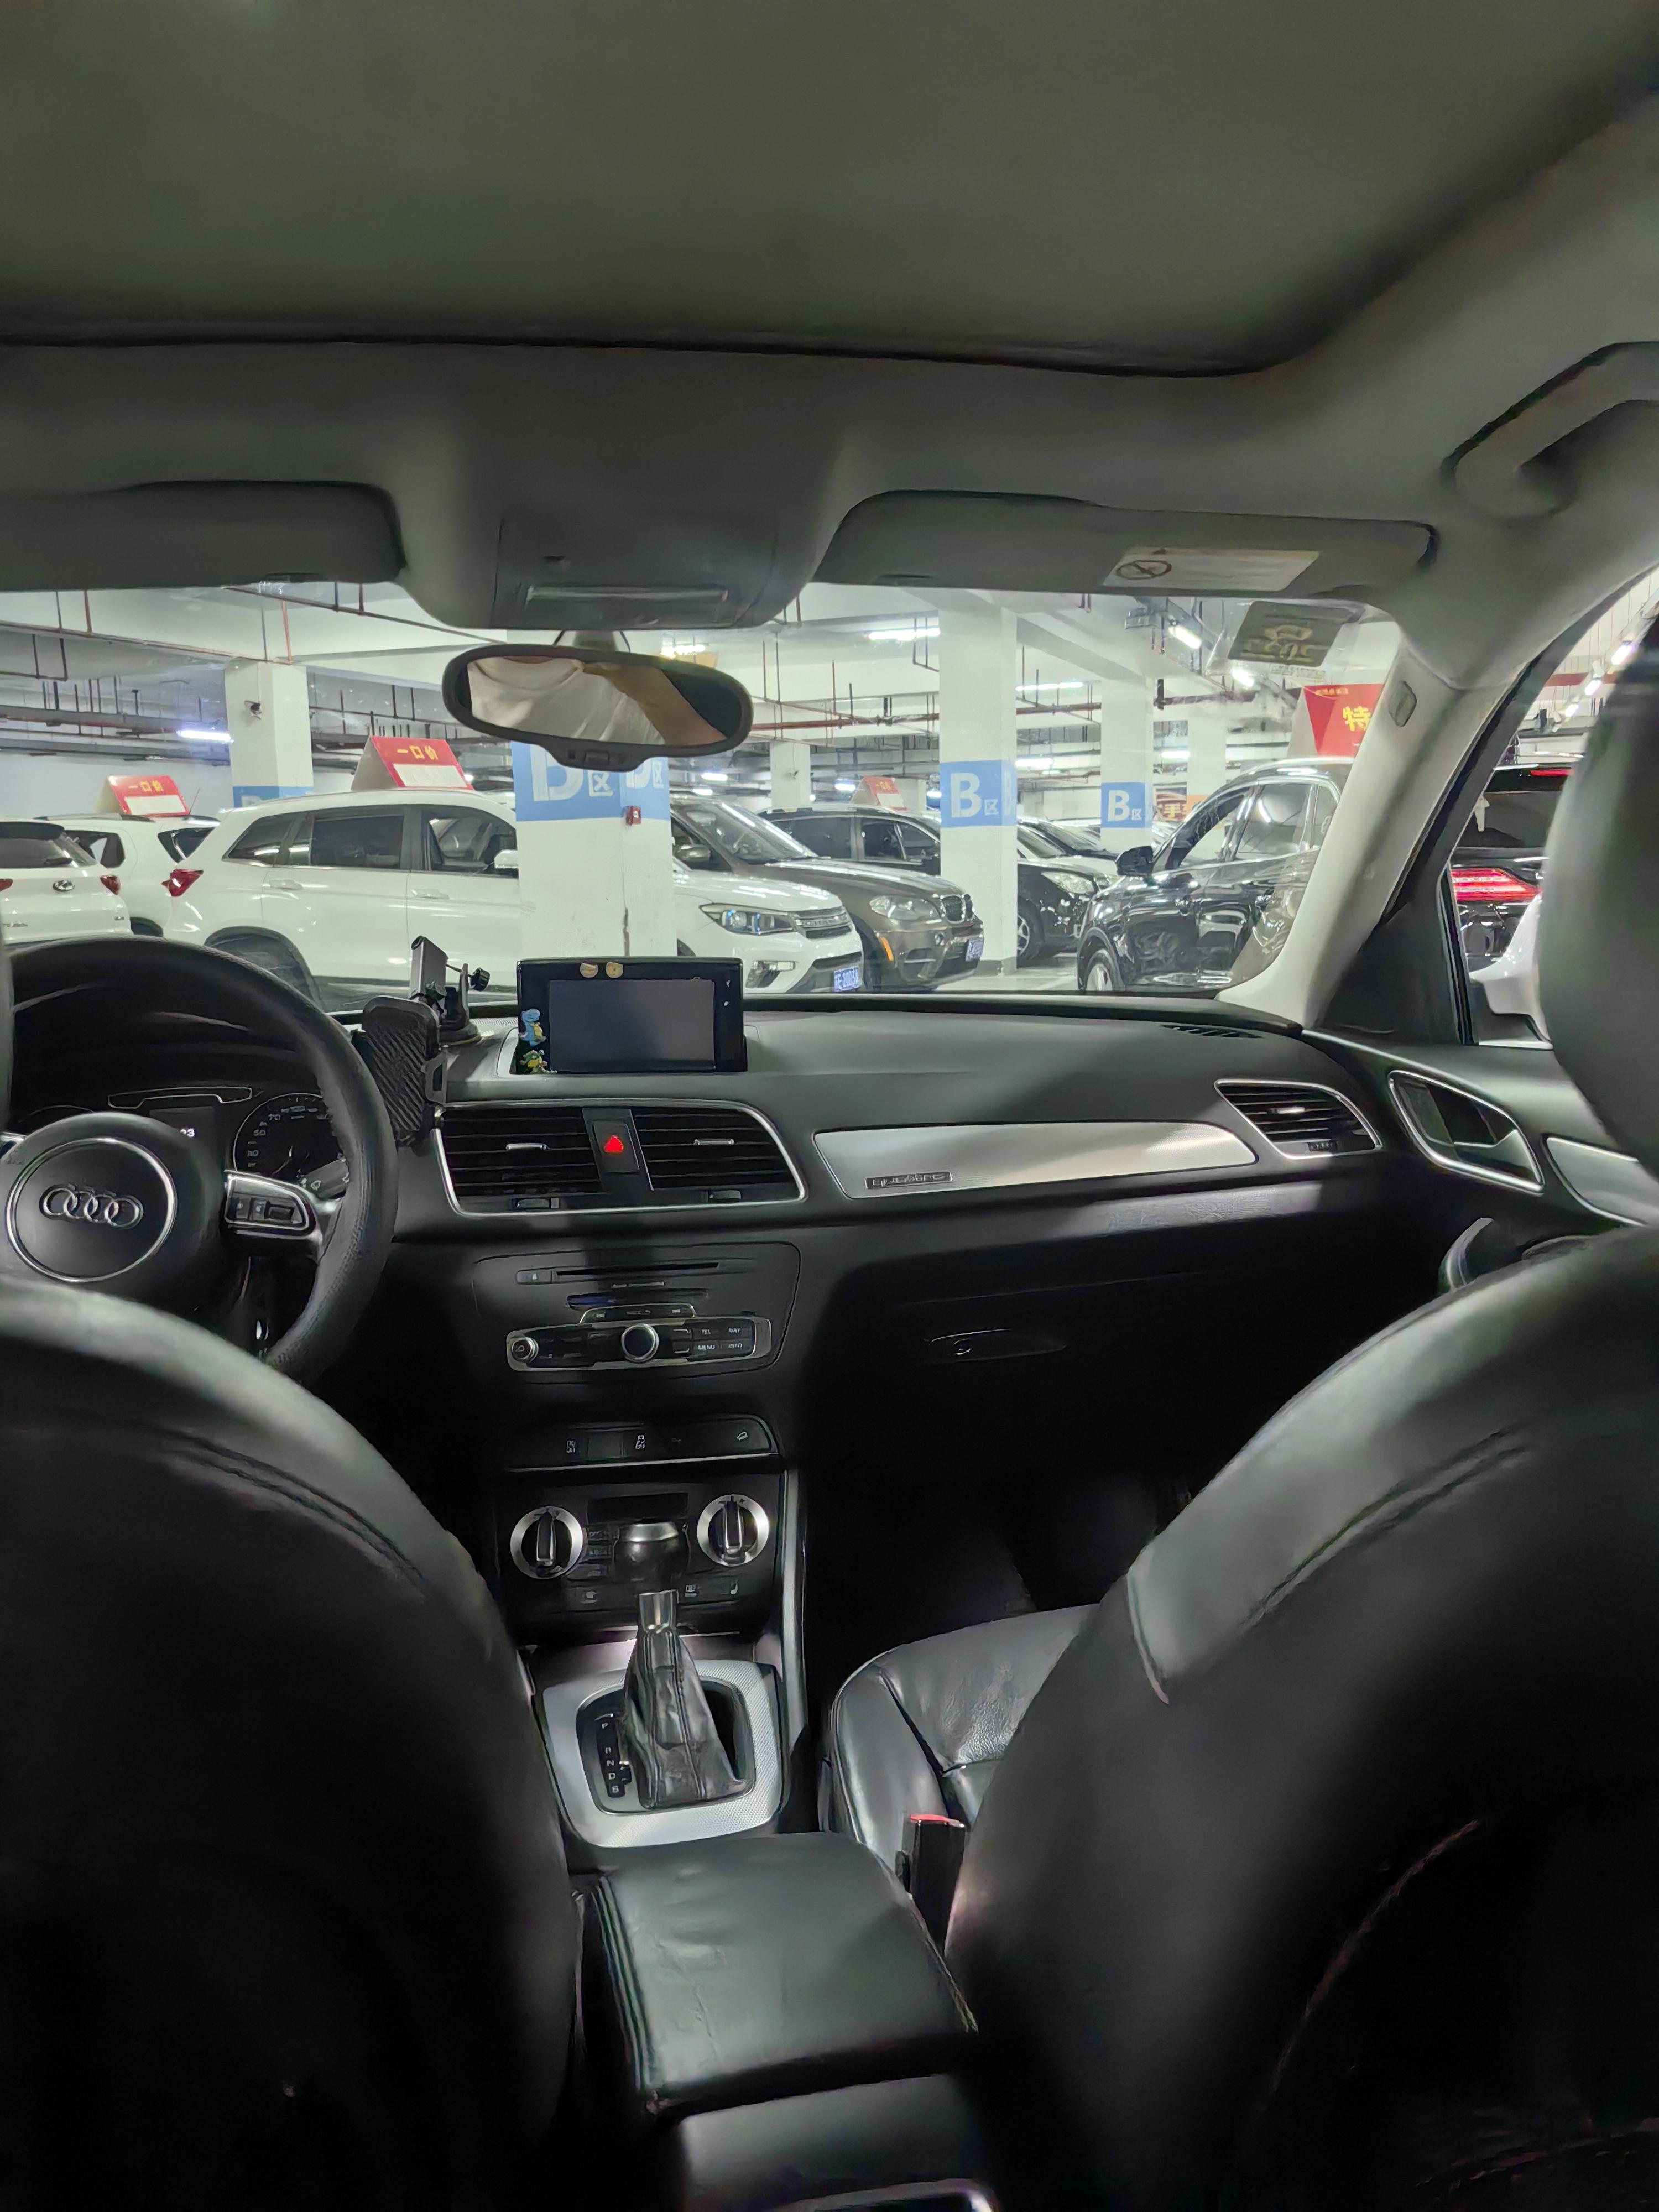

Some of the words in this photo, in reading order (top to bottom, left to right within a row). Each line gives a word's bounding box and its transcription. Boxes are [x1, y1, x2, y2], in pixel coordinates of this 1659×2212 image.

[397, 745, 439, 760] 一口价
[128, 780, 164, 792] 一口价
[951, 773, 999, 818] B区
[1108, 790, 1142, 822] B区
